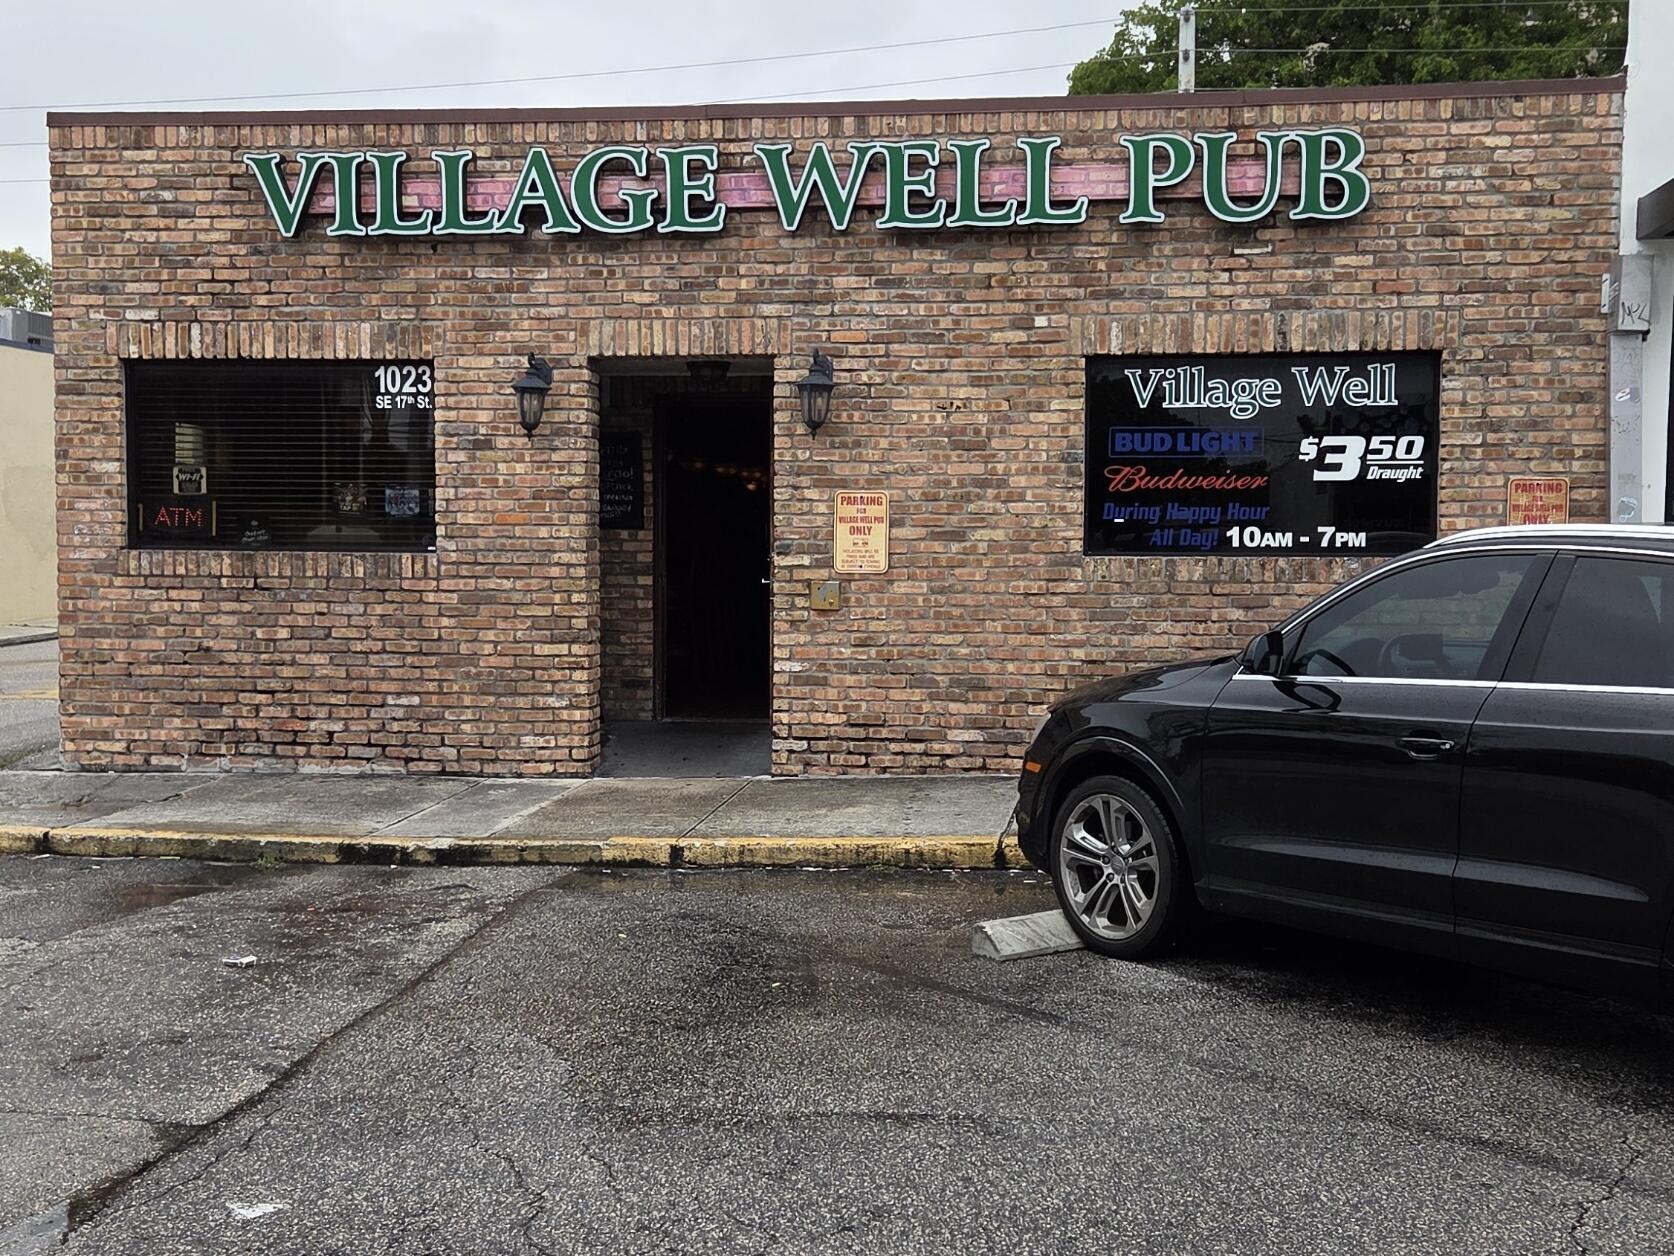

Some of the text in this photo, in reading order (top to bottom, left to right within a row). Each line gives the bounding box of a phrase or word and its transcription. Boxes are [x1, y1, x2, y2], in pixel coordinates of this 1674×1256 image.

[243, 127, 1371, 238] VILLAGE WELL PUB
[375, 365, 432, 393] 1023
[375, 395, 433, 409] SE 17th St.
[1125, 363, 1398, 419] Village Well
[1115, 432, 1258, 452] BUD LIGHT
[1104, 465, 1268, 492] Budweiser
[1366, 465, 1424, 482] Draught
[1514, 482, 1563, 494] PARKING
[840, 495, 883, 506] PARKING
[153, 506, 204, 528] ATM
[1103, 502, 1270, 524] During Happy Hour
[849, 525, 872, 536] ONLY
[1150, 528, 1173, 546] All
[1179, 528, 1219, 550] Day!
[1226, 526, 1293, 548] 10AM
[1317, 526, 1367, 548] 7PM
